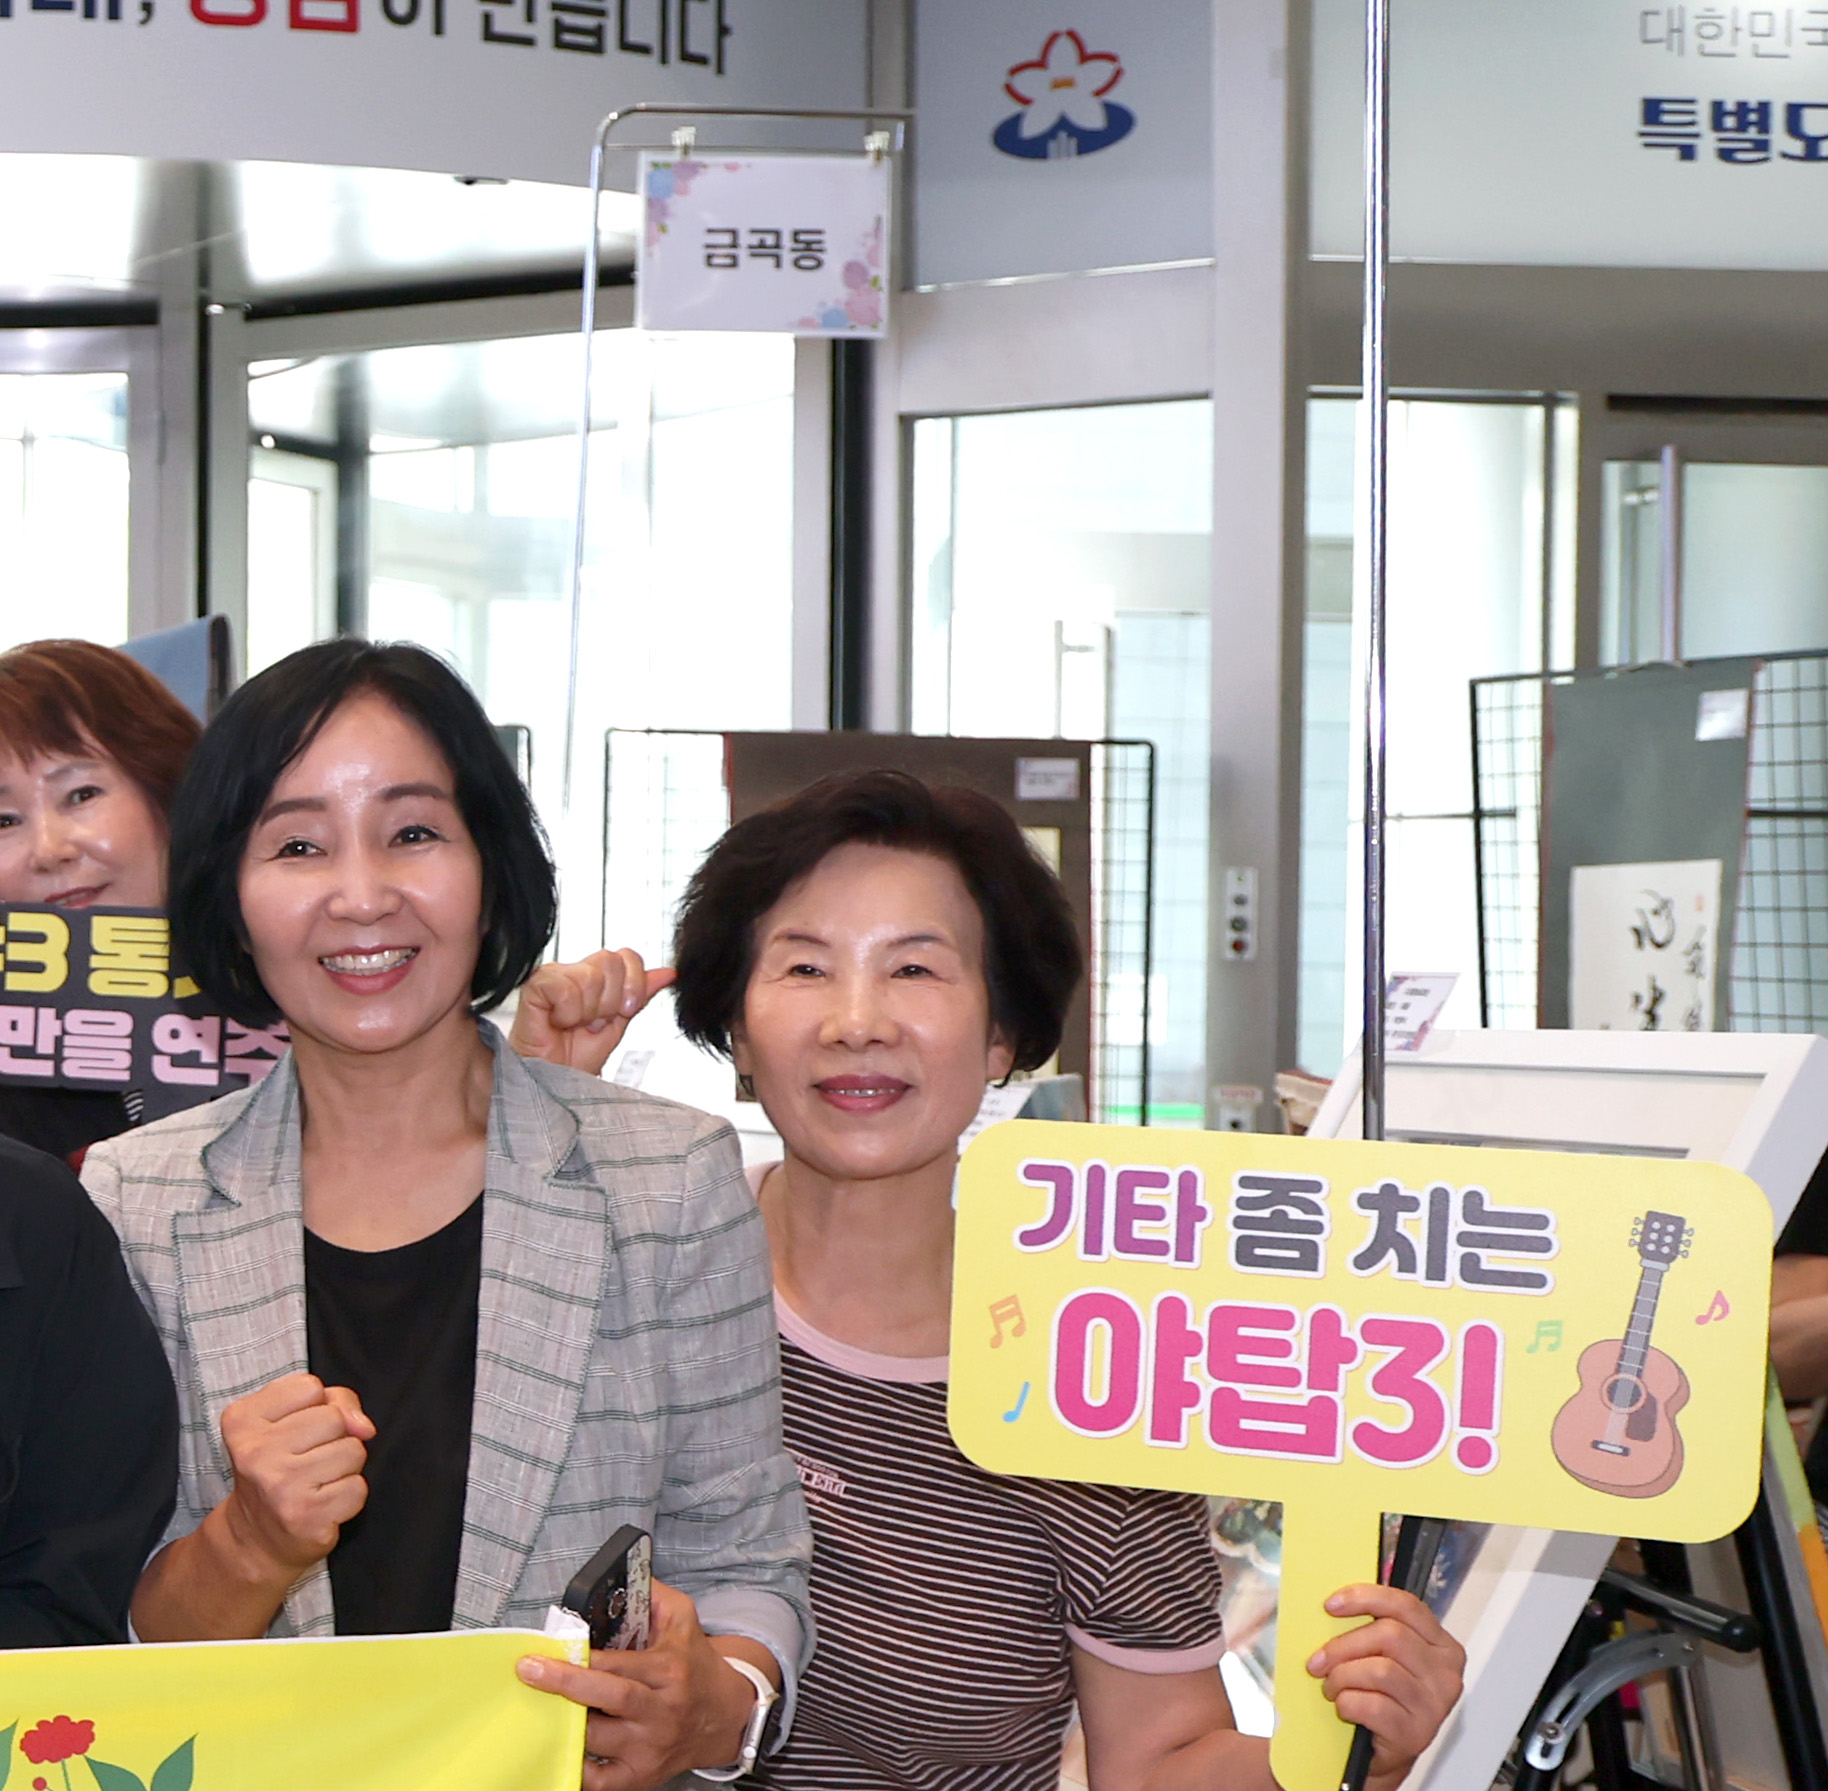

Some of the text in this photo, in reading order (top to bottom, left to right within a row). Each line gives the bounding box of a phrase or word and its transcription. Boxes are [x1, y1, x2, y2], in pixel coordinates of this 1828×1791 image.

[704, 227, 829, 272] 금곡동
[87, 915, 200, 999] 통
[1017, 1161, 1556, 1292] 기타 좀 치는
[1053, 1290, 1502, 1472] 야탑3!
